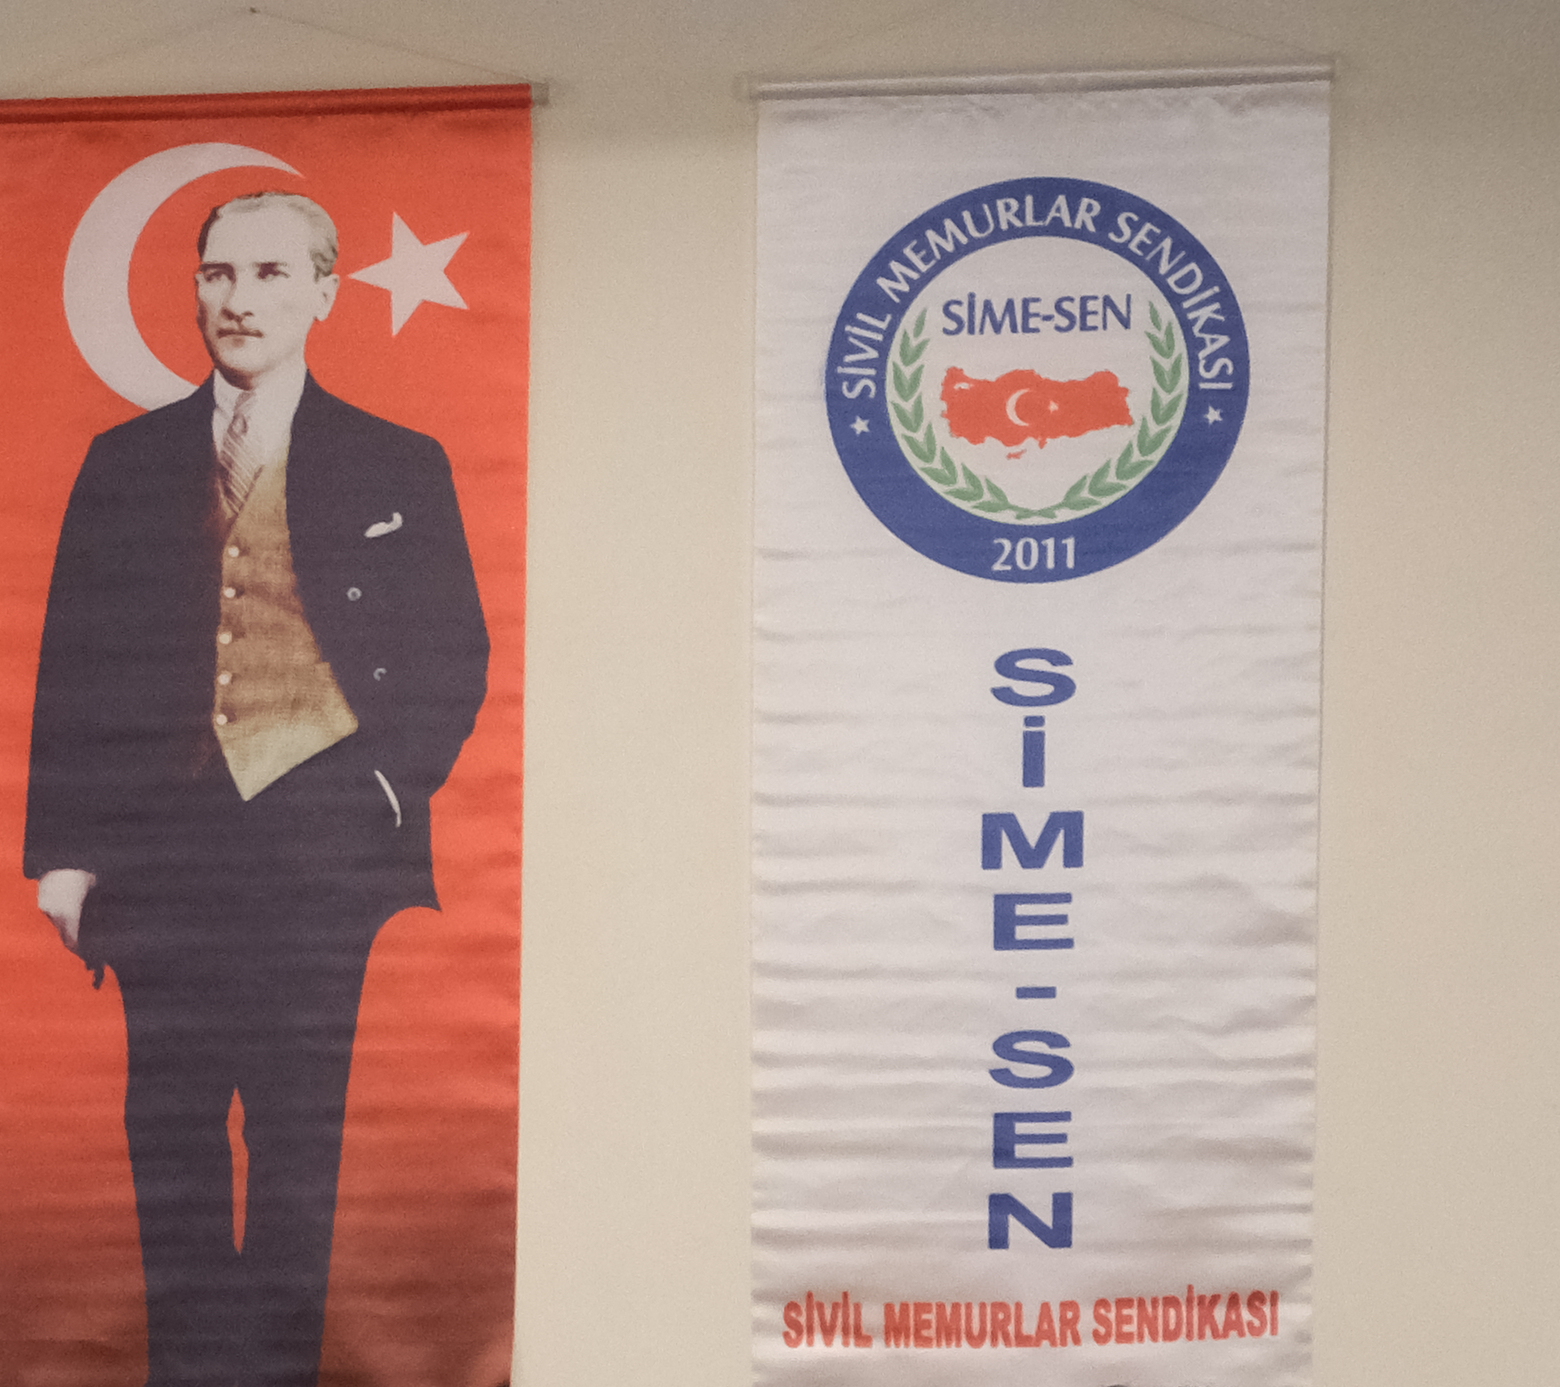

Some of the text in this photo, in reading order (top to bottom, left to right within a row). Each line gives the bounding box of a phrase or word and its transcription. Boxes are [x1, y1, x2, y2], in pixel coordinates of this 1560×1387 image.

[838, 195, 1234, 398] SİVİL MEMURLAR SENDİKASI
[942, 292, 1133, 336] SİME-SEN
[992, 538, 1076, 570] 2011
[981, 648, 1084, 1250] SİME-SEN
[782, 1284, 1281, 1350] SİVİL MEMURLAR SENDİKASI
